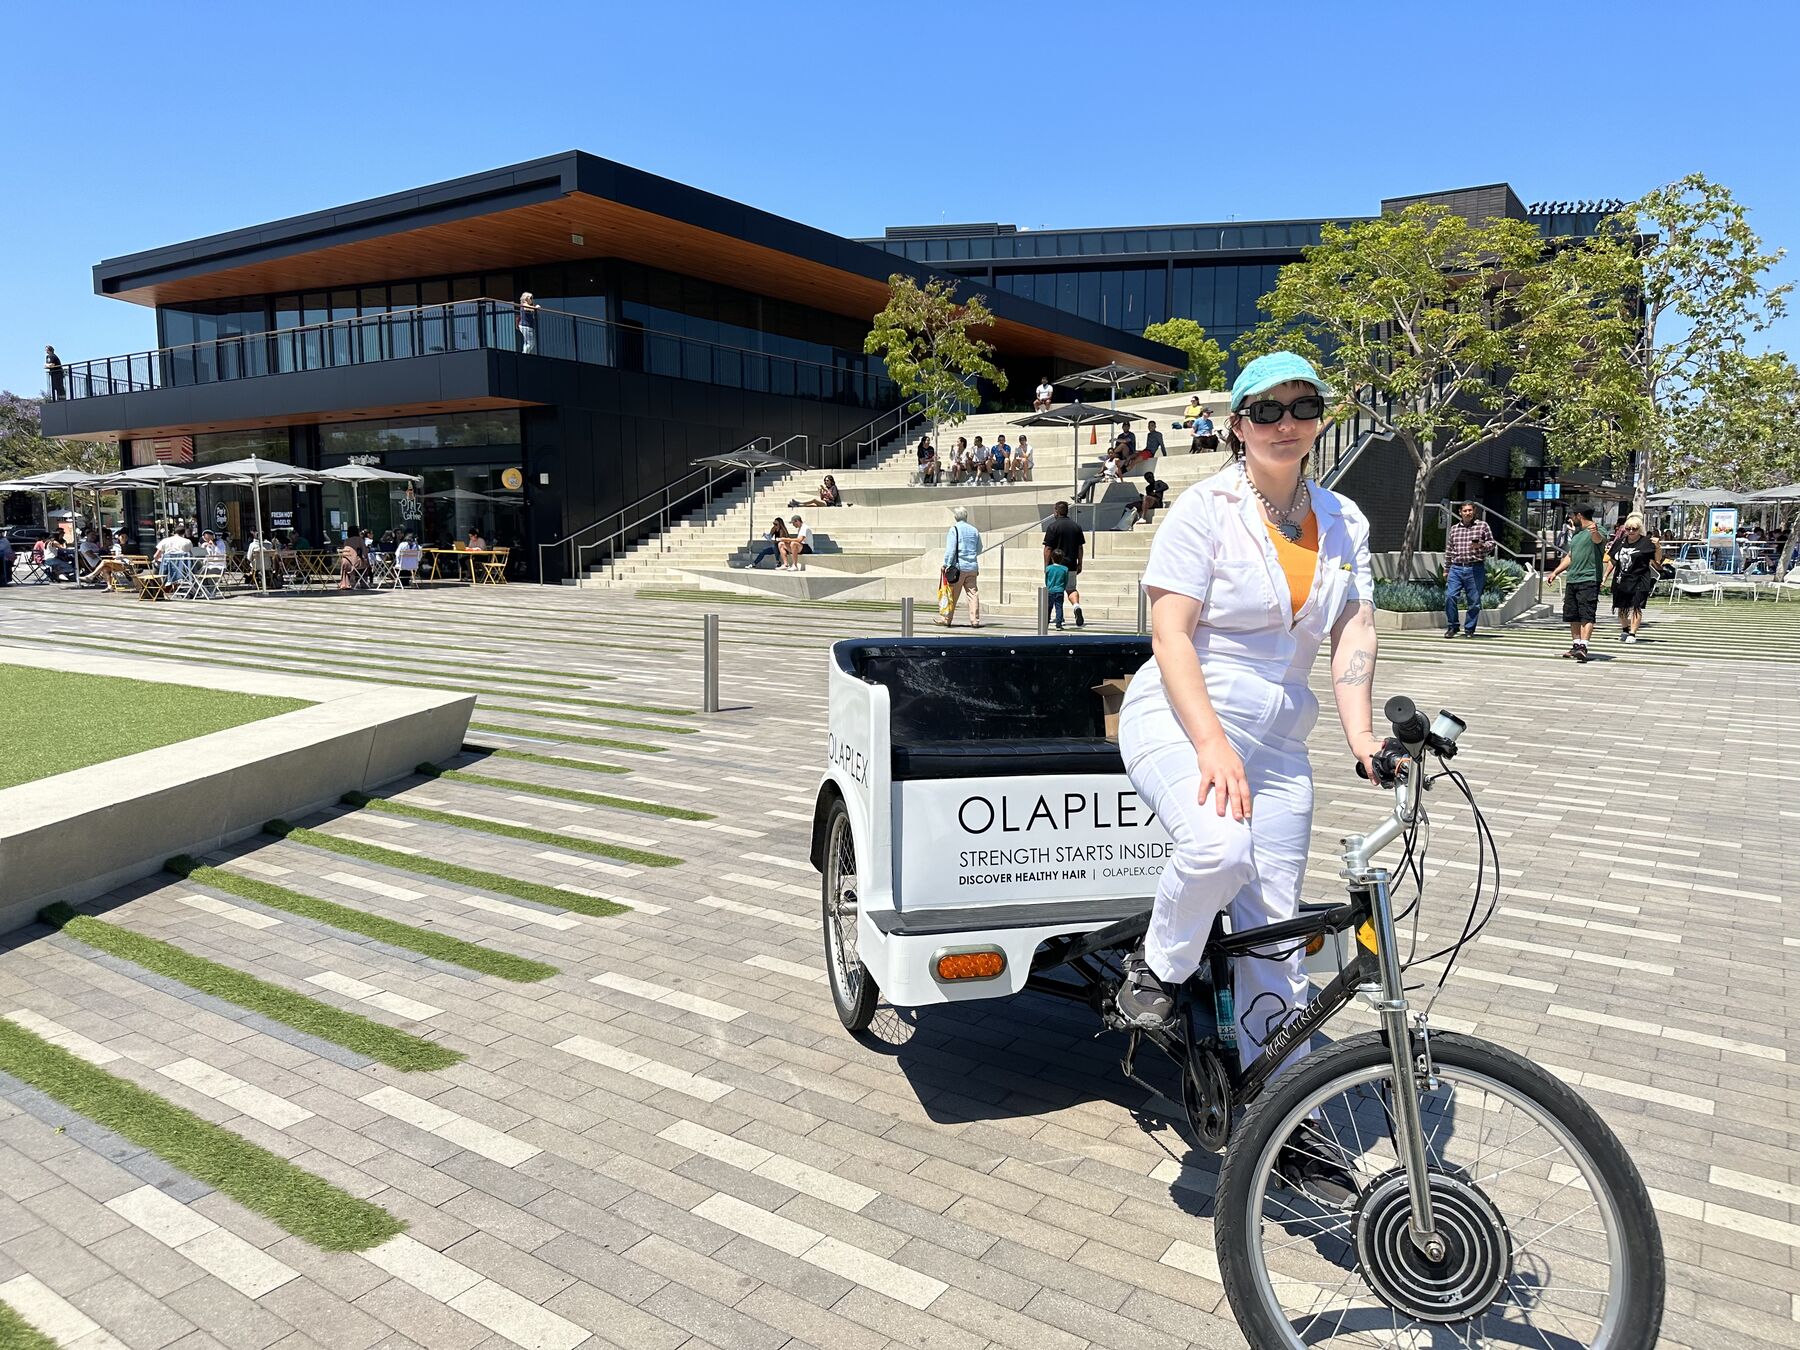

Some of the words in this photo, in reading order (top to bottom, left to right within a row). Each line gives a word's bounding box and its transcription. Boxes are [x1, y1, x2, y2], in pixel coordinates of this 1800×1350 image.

[403, 511, 421, 520] Coffee
[828, 733, 869, 788] OLAPLEX
[958, 791, 1156, 834] OLAPLE
[959, 847, 1050, 868] STRENGTH
[1056, 844, 1113, 862] STARTS
[1119, 842, 1174, 860] INSIDE
[959, 873, 1012, 885] DISCOVER
[1015, 870, 1058, 883] HEALTHY
[1062, 869, 1086, 880] HAIR
